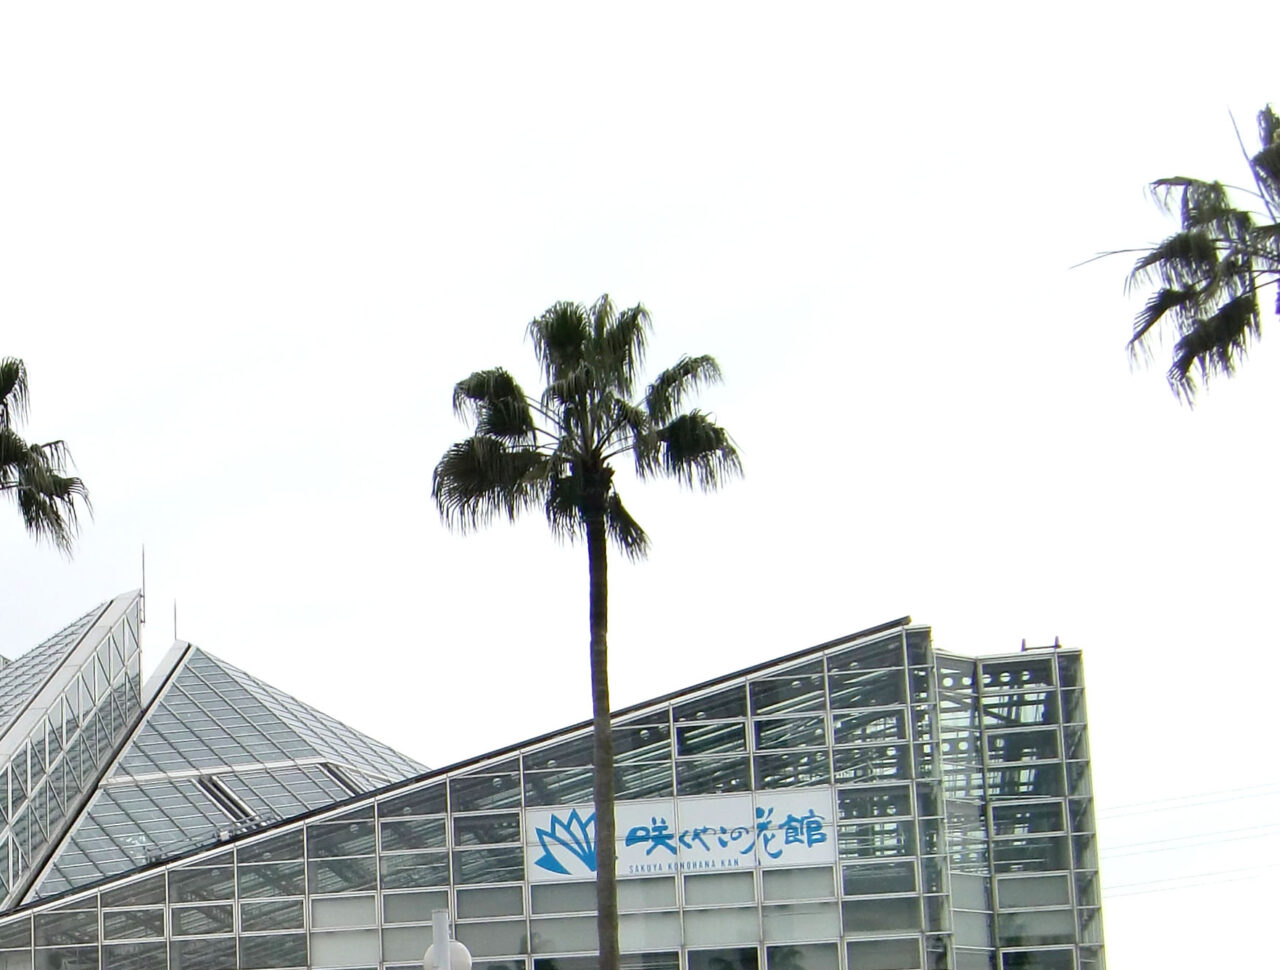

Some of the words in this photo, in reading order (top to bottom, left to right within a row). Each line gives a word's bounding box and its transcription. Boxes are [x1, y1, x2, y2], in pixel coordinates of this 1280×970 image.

[625, 806, 828, 859] 咲くやこの花館
[629, 863, 663, 874] SAKUYA
[668, 859, 716, 871] KONOHANA
[721, 858, 739, 867] KAN
